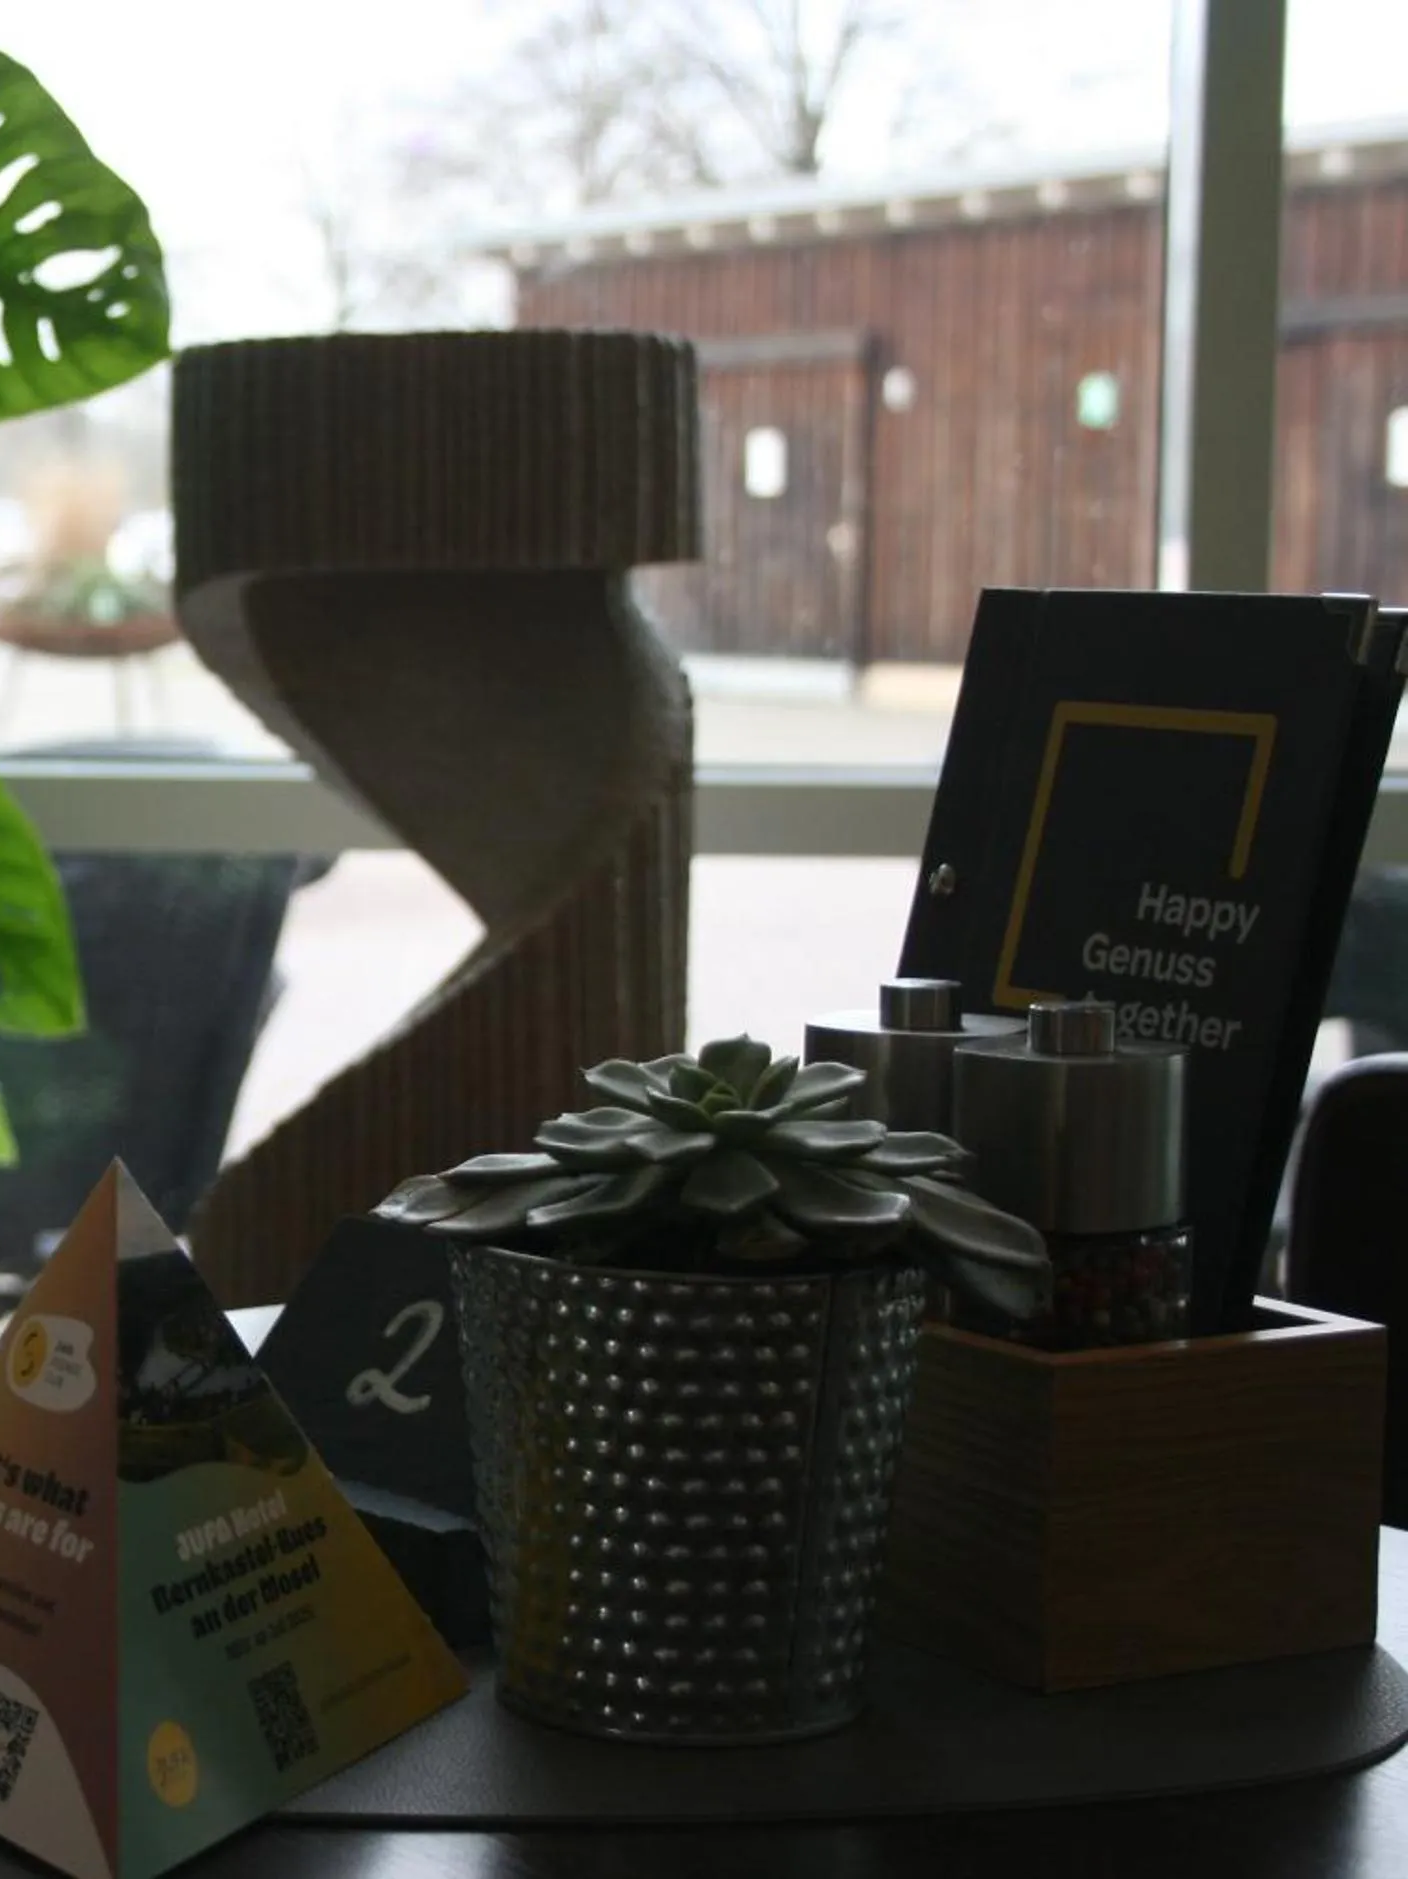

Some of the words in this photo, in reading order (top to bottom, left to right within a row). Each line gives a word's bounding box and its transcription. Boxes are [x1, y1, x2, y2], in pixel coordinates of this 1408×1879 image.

[1136, 881, 1261, 944] Happy
[1082, 932, 1217, 988] Genuss
[1081, 991, 1243, 1051] gether
[345, 1299, 445, 1415] 2
[23, 1469, 90, 1517] what
[4, 1508, 50, 1546] are
[48, 1518, 96, 1565] for
[176, 1515, 235, 1562] JUFA
[230, 1486, 289, 1539] Hotel
[190, 1608, 223, 1640] an
[222, 1588, 259, 1623] der
[258, 1552, 321, 1605] Mosel
